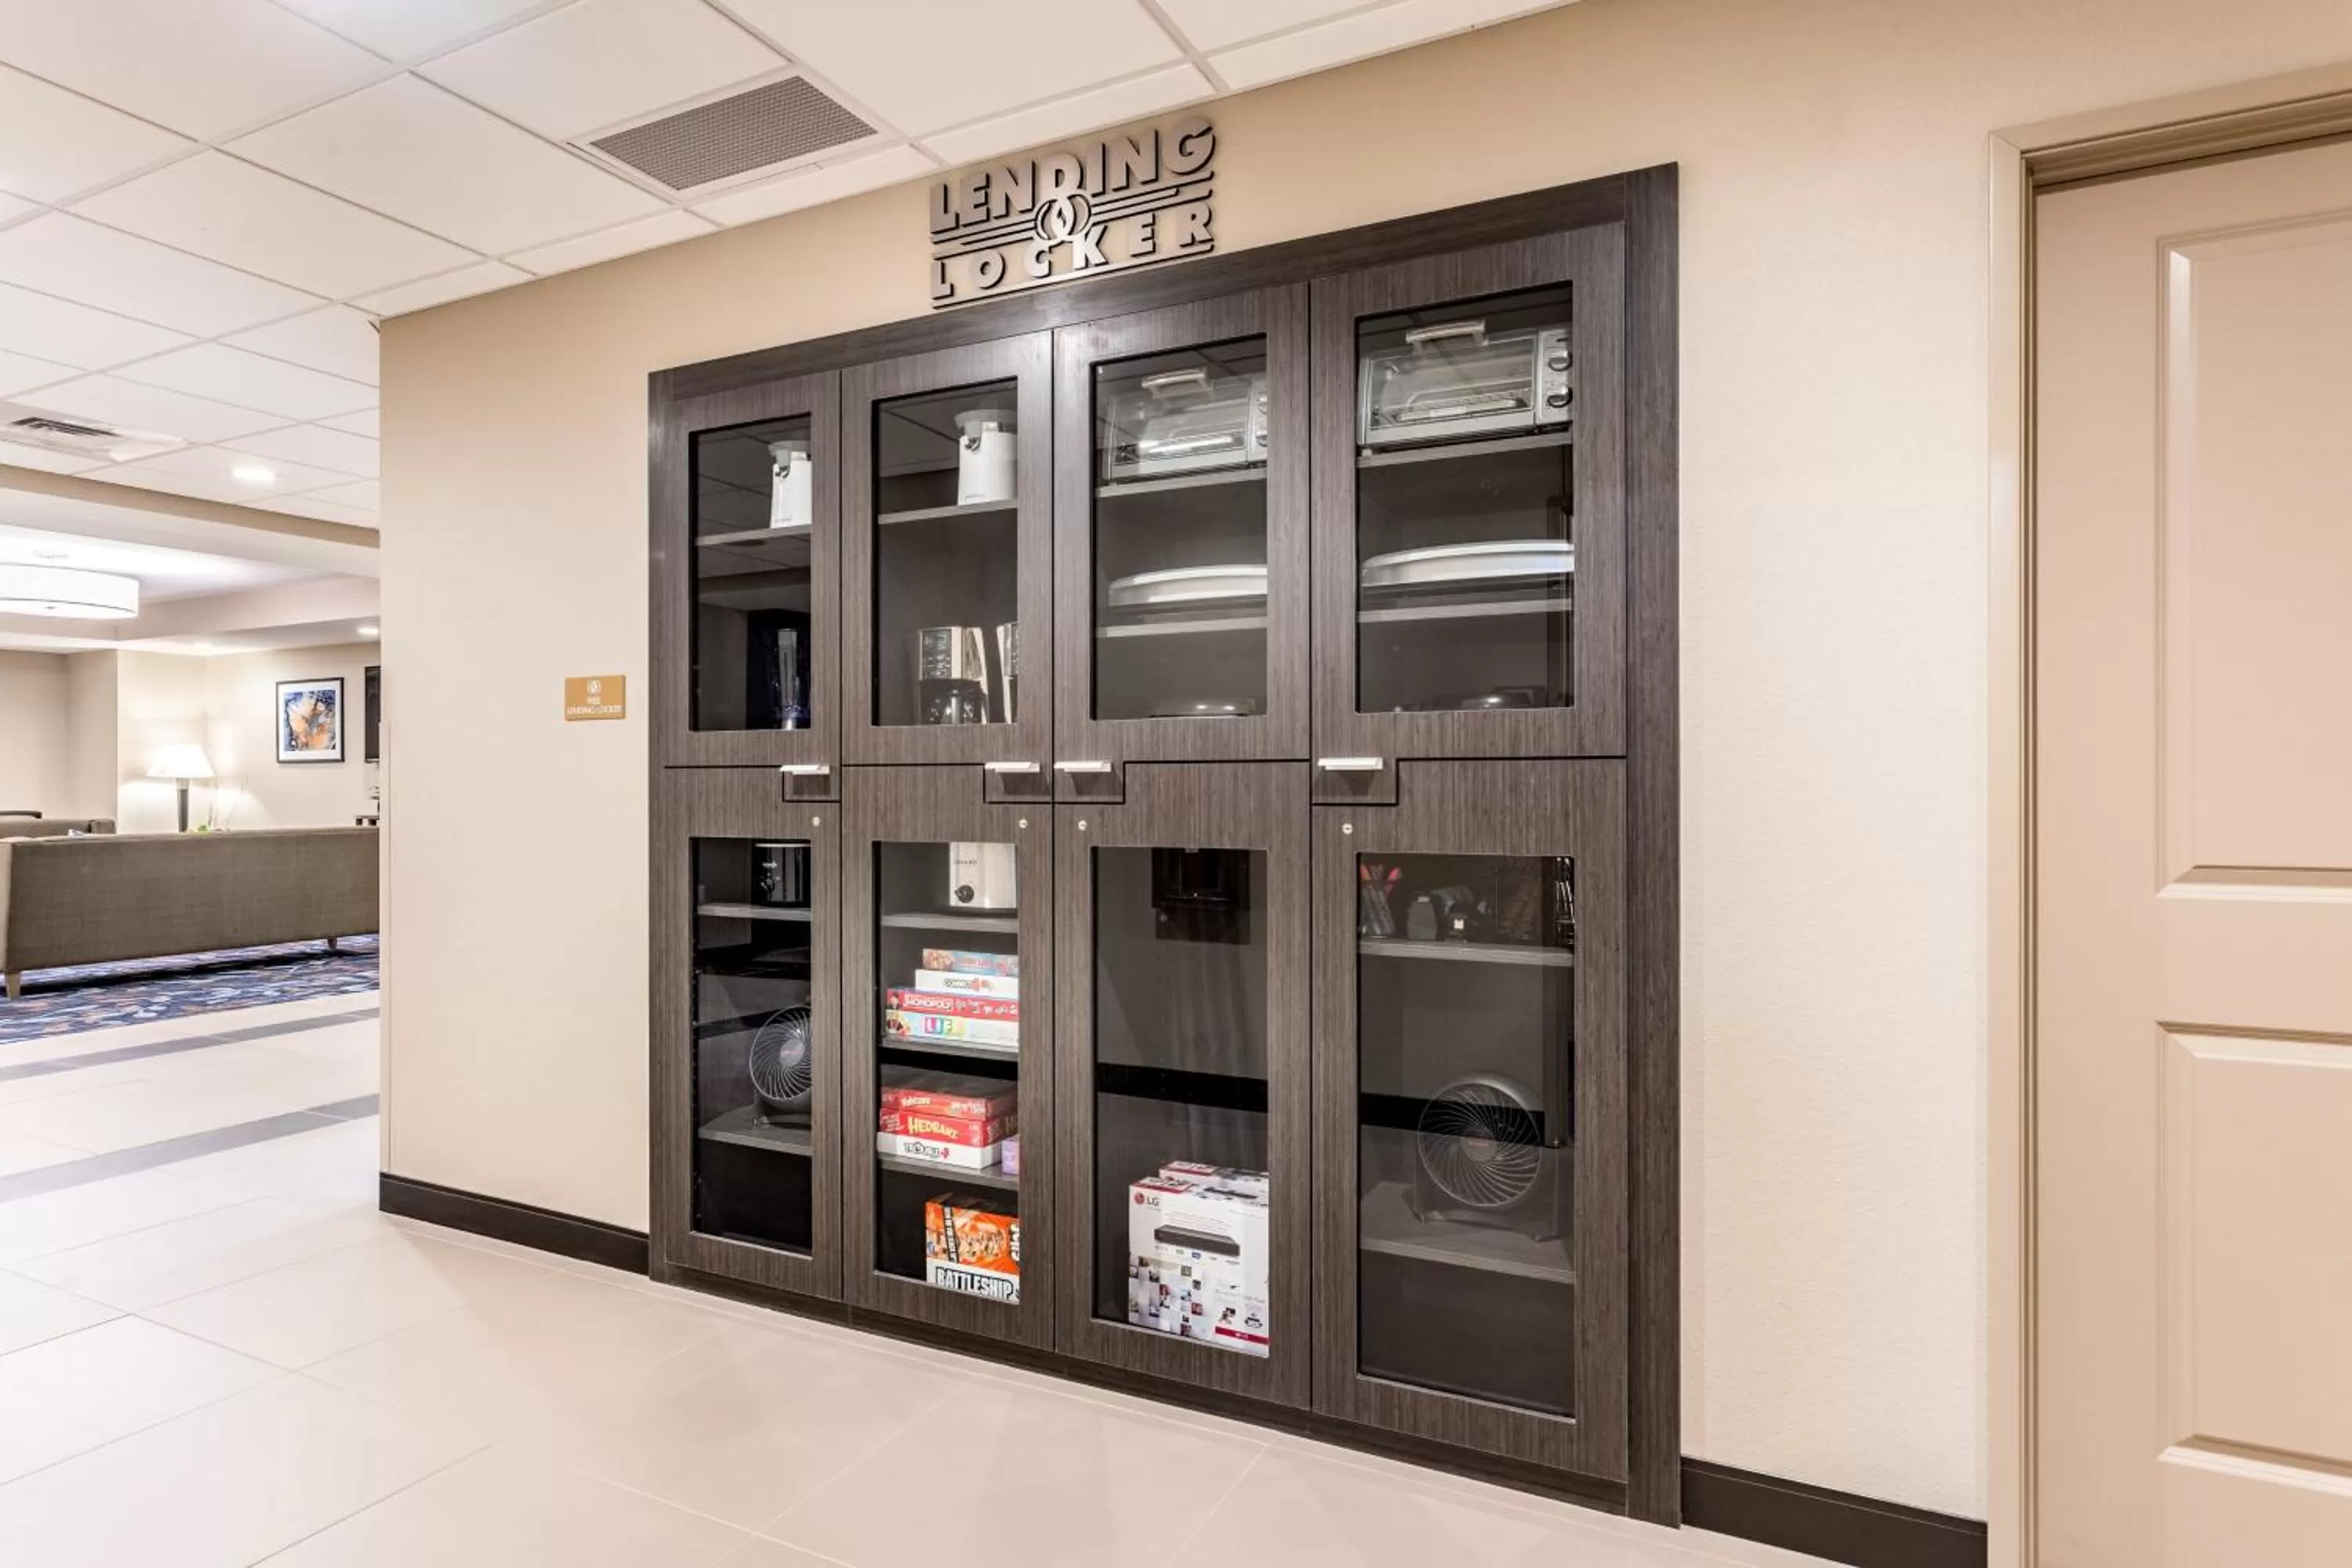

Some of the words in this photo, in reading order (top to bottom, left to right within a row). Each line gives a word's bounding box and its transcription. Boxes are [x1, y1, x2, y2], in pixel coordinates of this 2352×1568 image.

[930, 116, 1216, 234] LENDING
[931, 202, 1216, 300] LOCKER
[1146, 1196, 1160, 1207] LG
[936, 1266, 1013, 1301] BATTLESHIP
